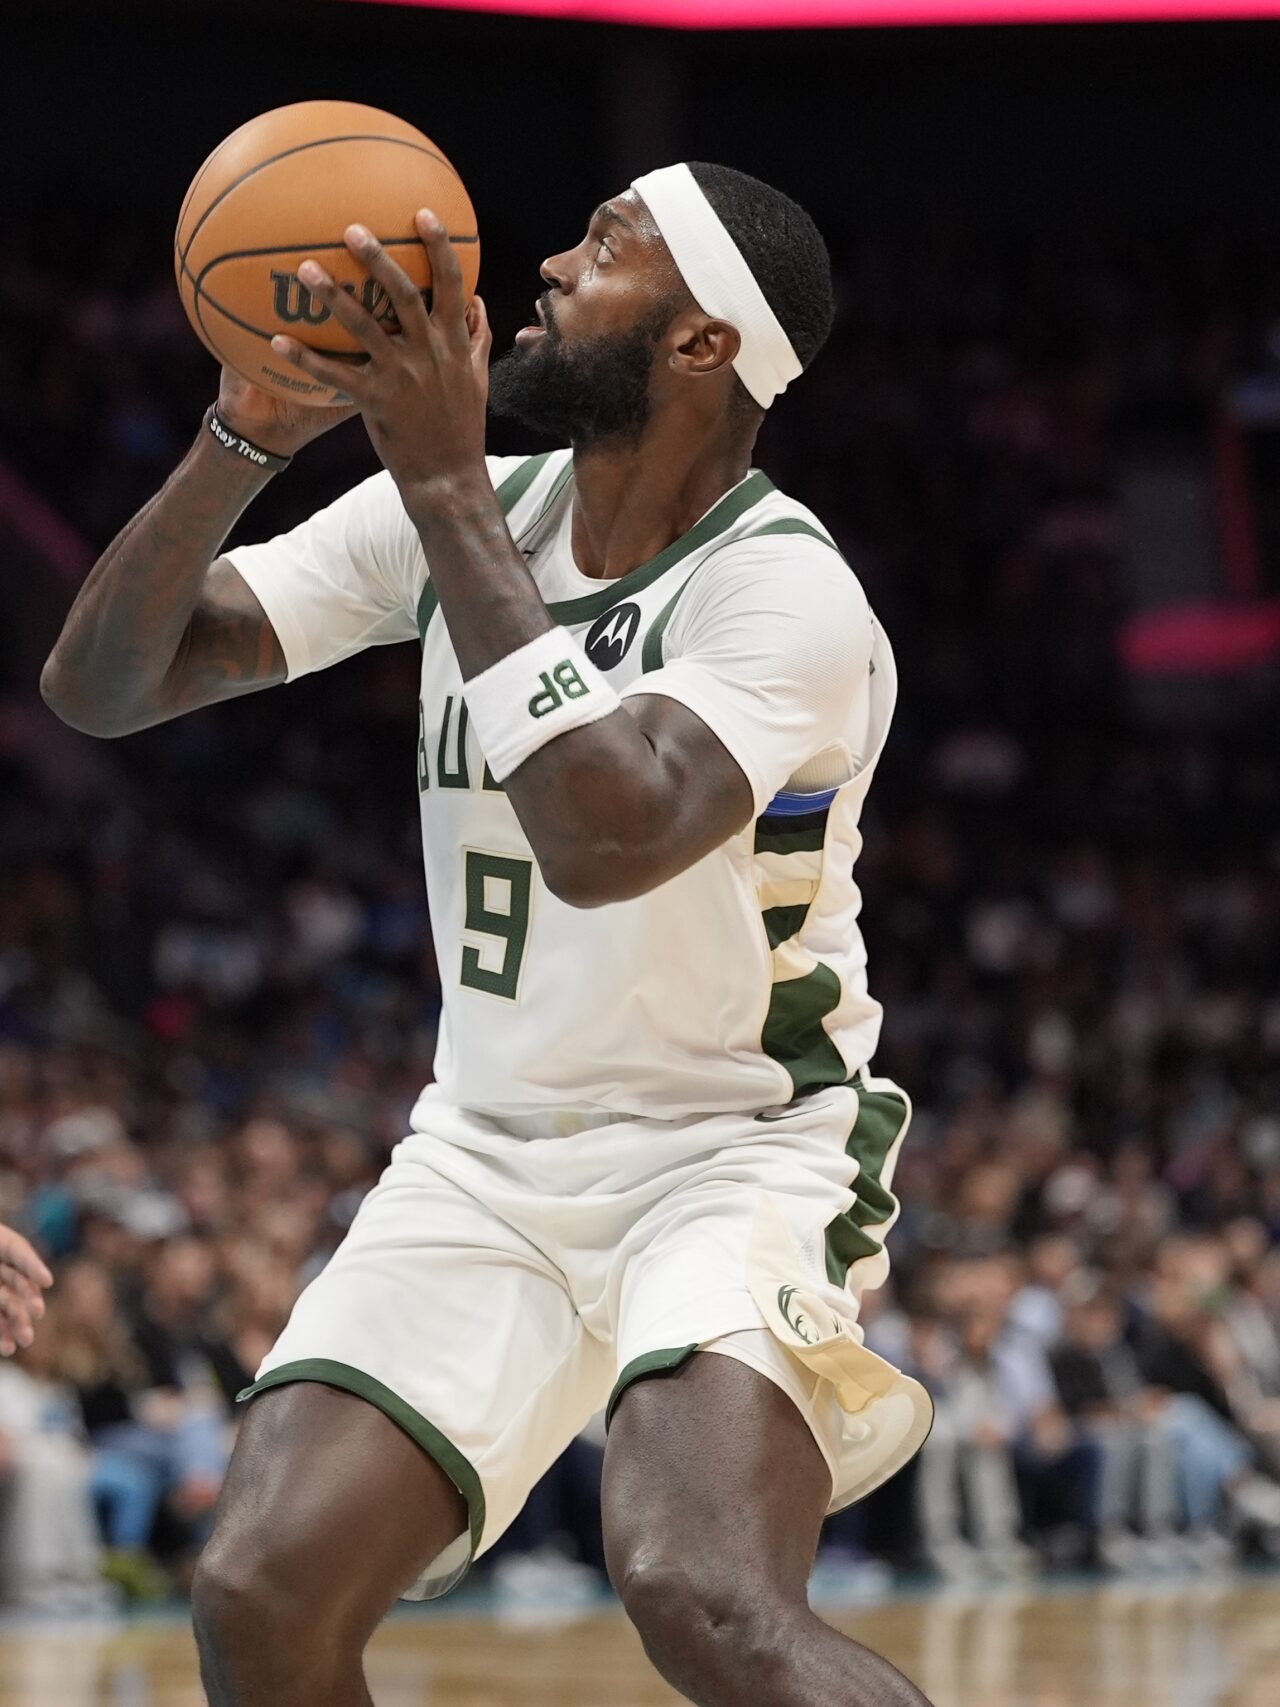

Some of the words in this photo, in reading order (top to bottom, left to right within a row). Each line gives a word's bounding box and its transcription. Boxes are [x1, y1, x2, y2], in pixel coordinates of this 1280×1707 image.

[210, 418, 237, 448] Stay
[237, 440, 267, 465] True
[528, 658, 591, 720] BP
[458, 847, 535, 1004] 9
